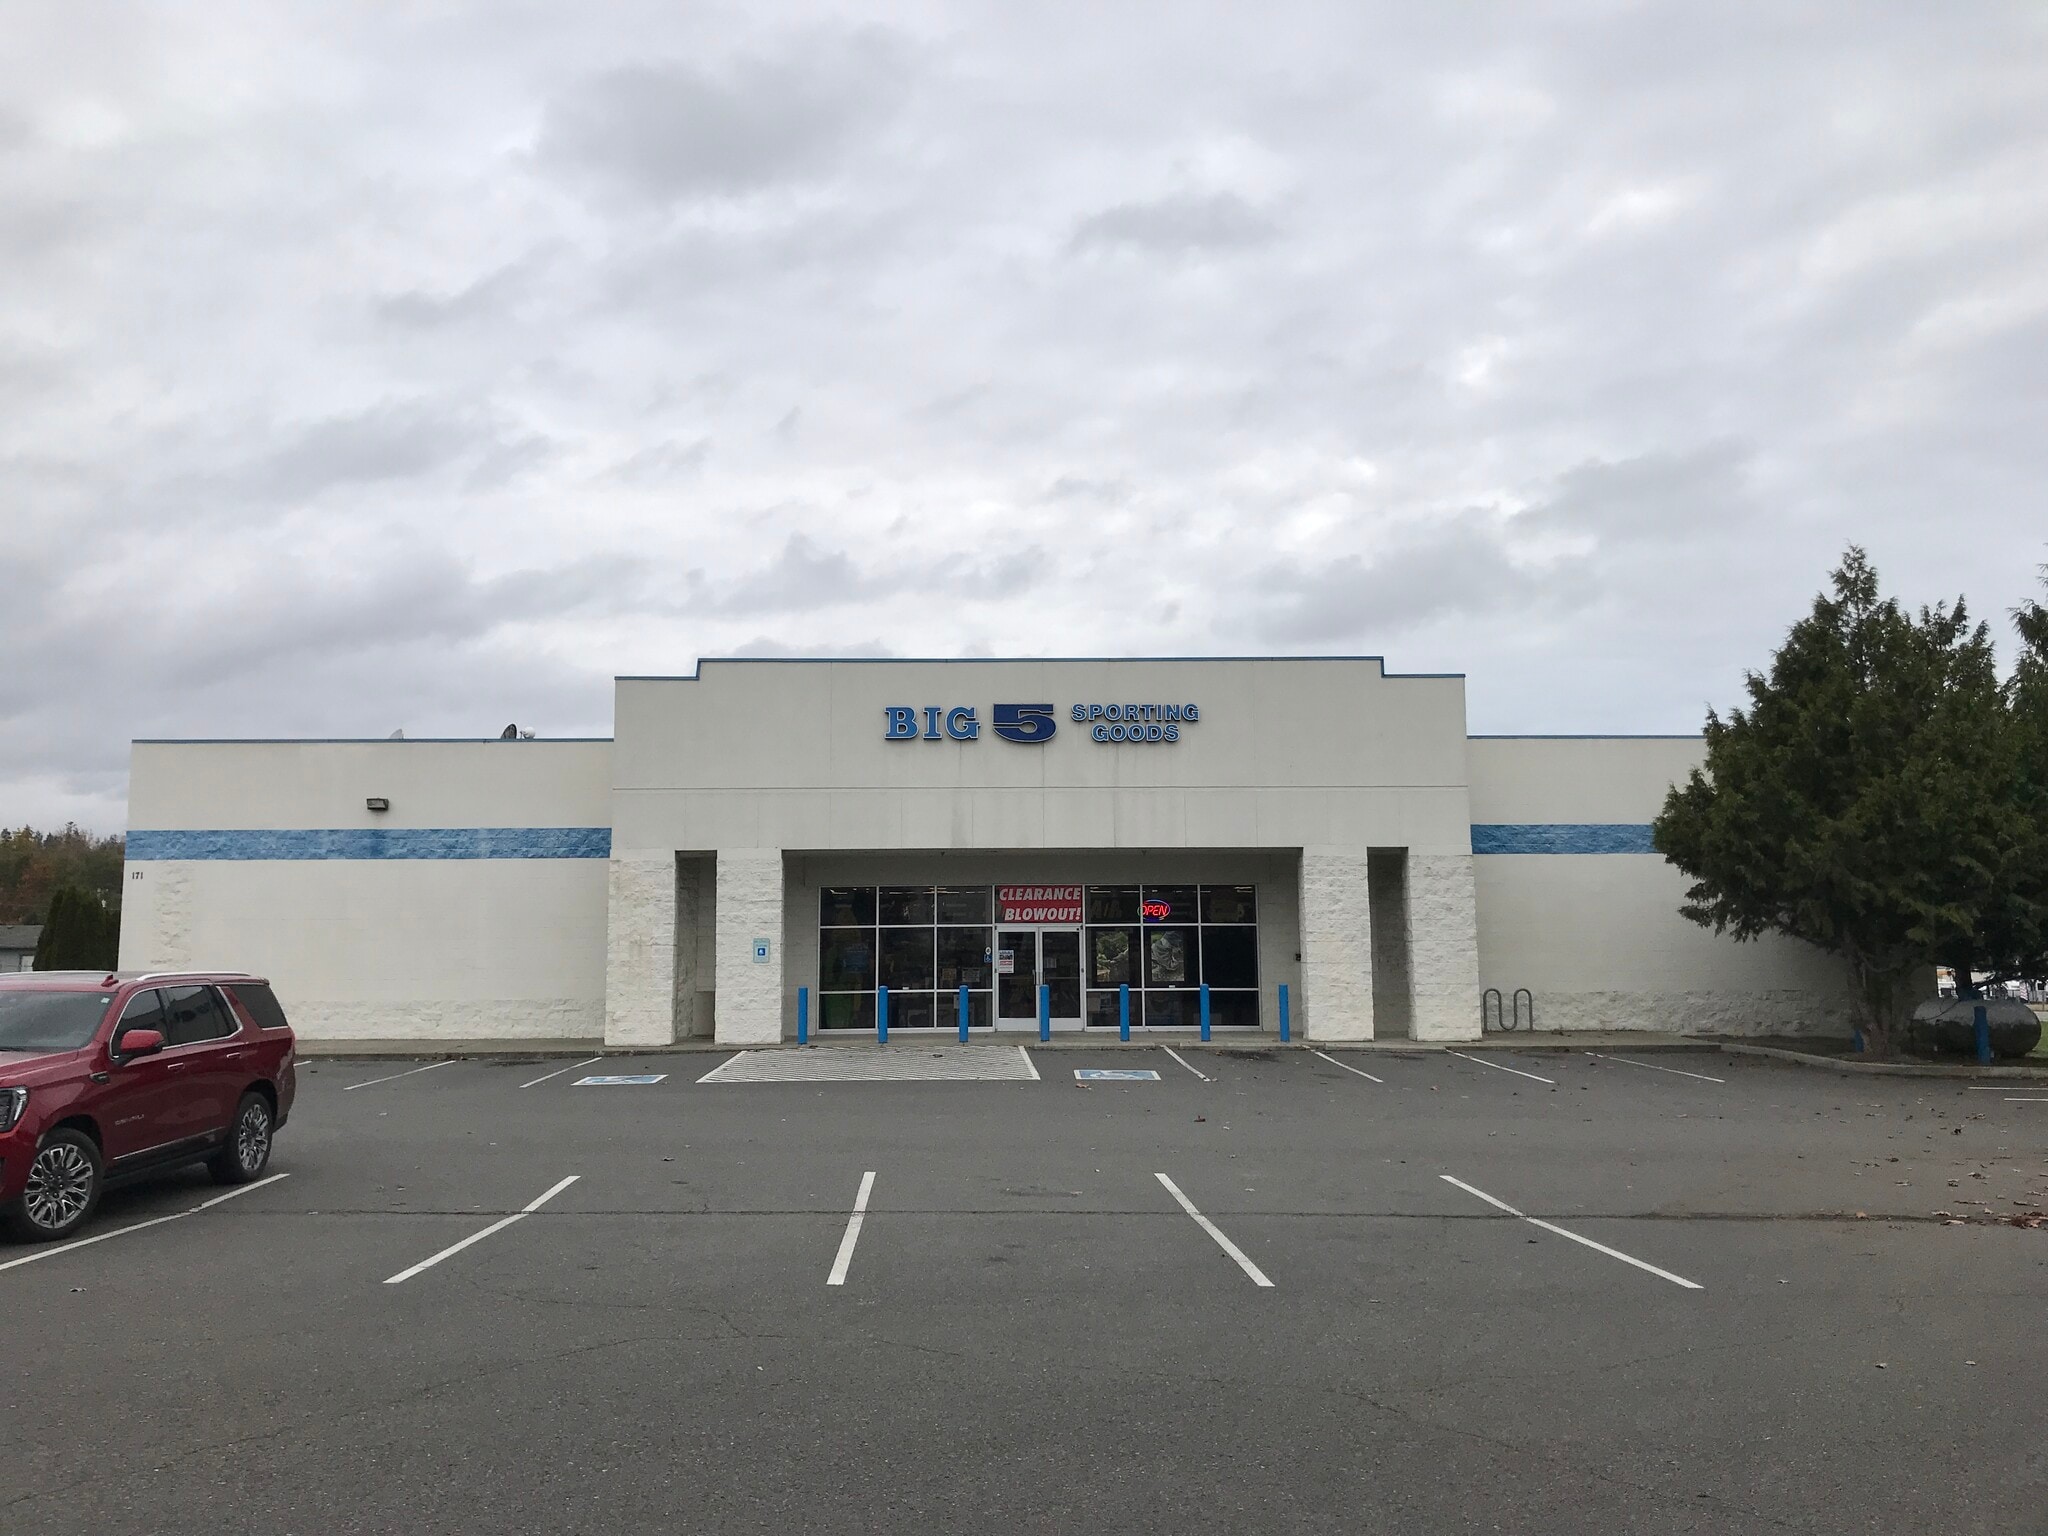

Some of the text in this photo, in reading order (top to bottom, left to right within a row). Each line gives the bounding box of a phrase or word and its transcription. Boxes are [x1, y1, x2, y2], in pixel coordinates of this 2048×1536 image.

[1071, 703, 1199, 722] SPORTING
[885, 703, 1057, 743] BIG 5
[1091, 723, 1181, 742] GOODS
[132, 871, 144, 880] 171
[1000, 887, 1081, 901] CLEARANCE
[1004, 907, 1082, 921] BLOWOUT!
[1141, 905, 1168, 916] OPEN
